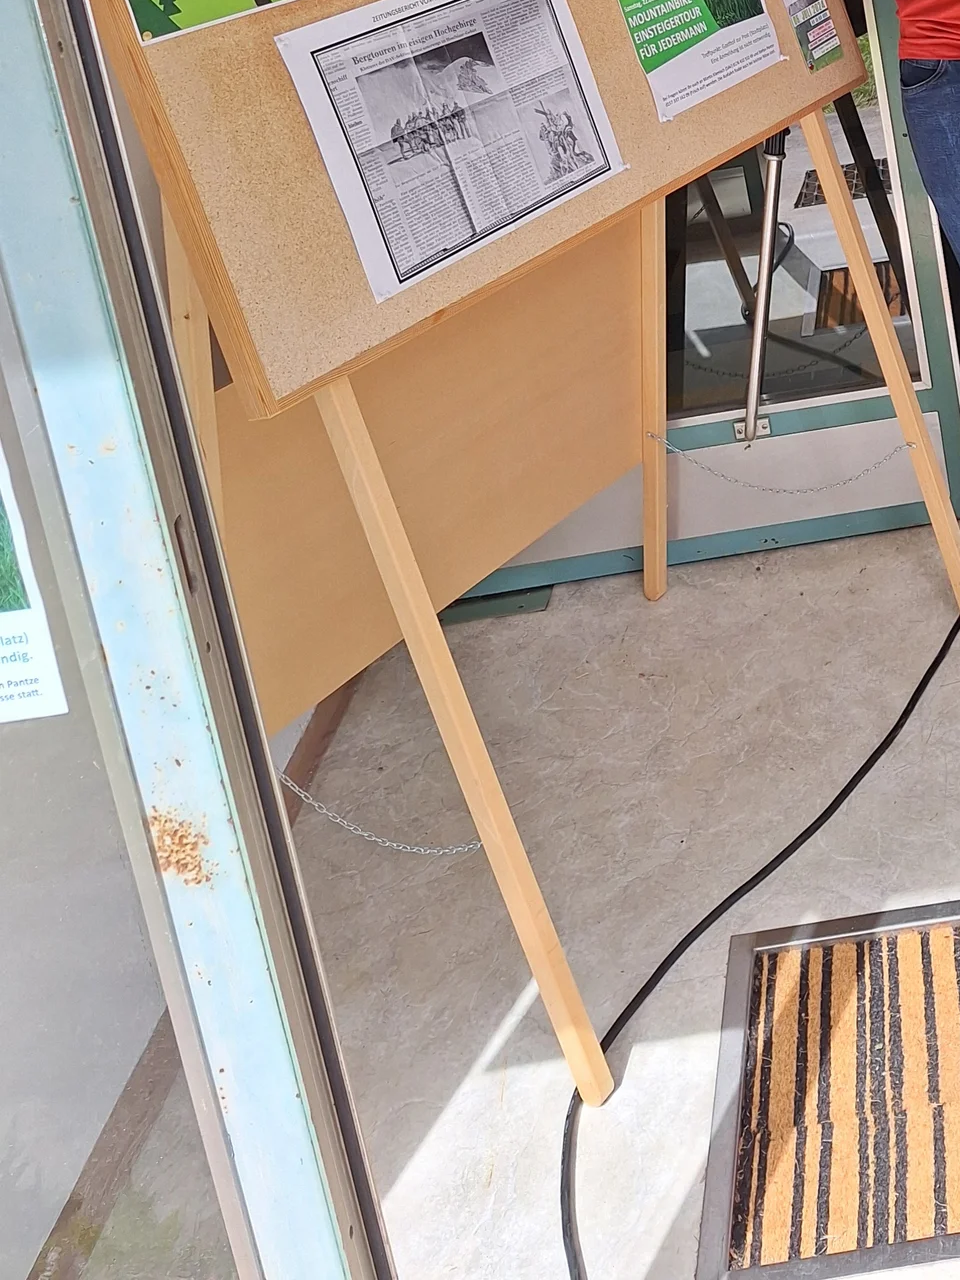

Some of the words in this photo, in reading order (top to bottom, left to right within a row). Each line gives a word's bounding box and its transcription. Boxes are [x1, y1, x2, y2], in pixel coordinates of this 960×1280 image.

[371, 0, 420, 23] ZEITUNGSBERICHT
[633, 6, 702, 44] EINSTEIGERTOUR
[351, 45, 397, 65] Bergtouren
[395, 40, 408, 50] im
[407, 33, 434, 47] eisigen
[432, 17, 477, 37] Hochgebirge
[638, 43, 658, 60] FÜR
[657, 20, 708, 52] JEDERMANN
